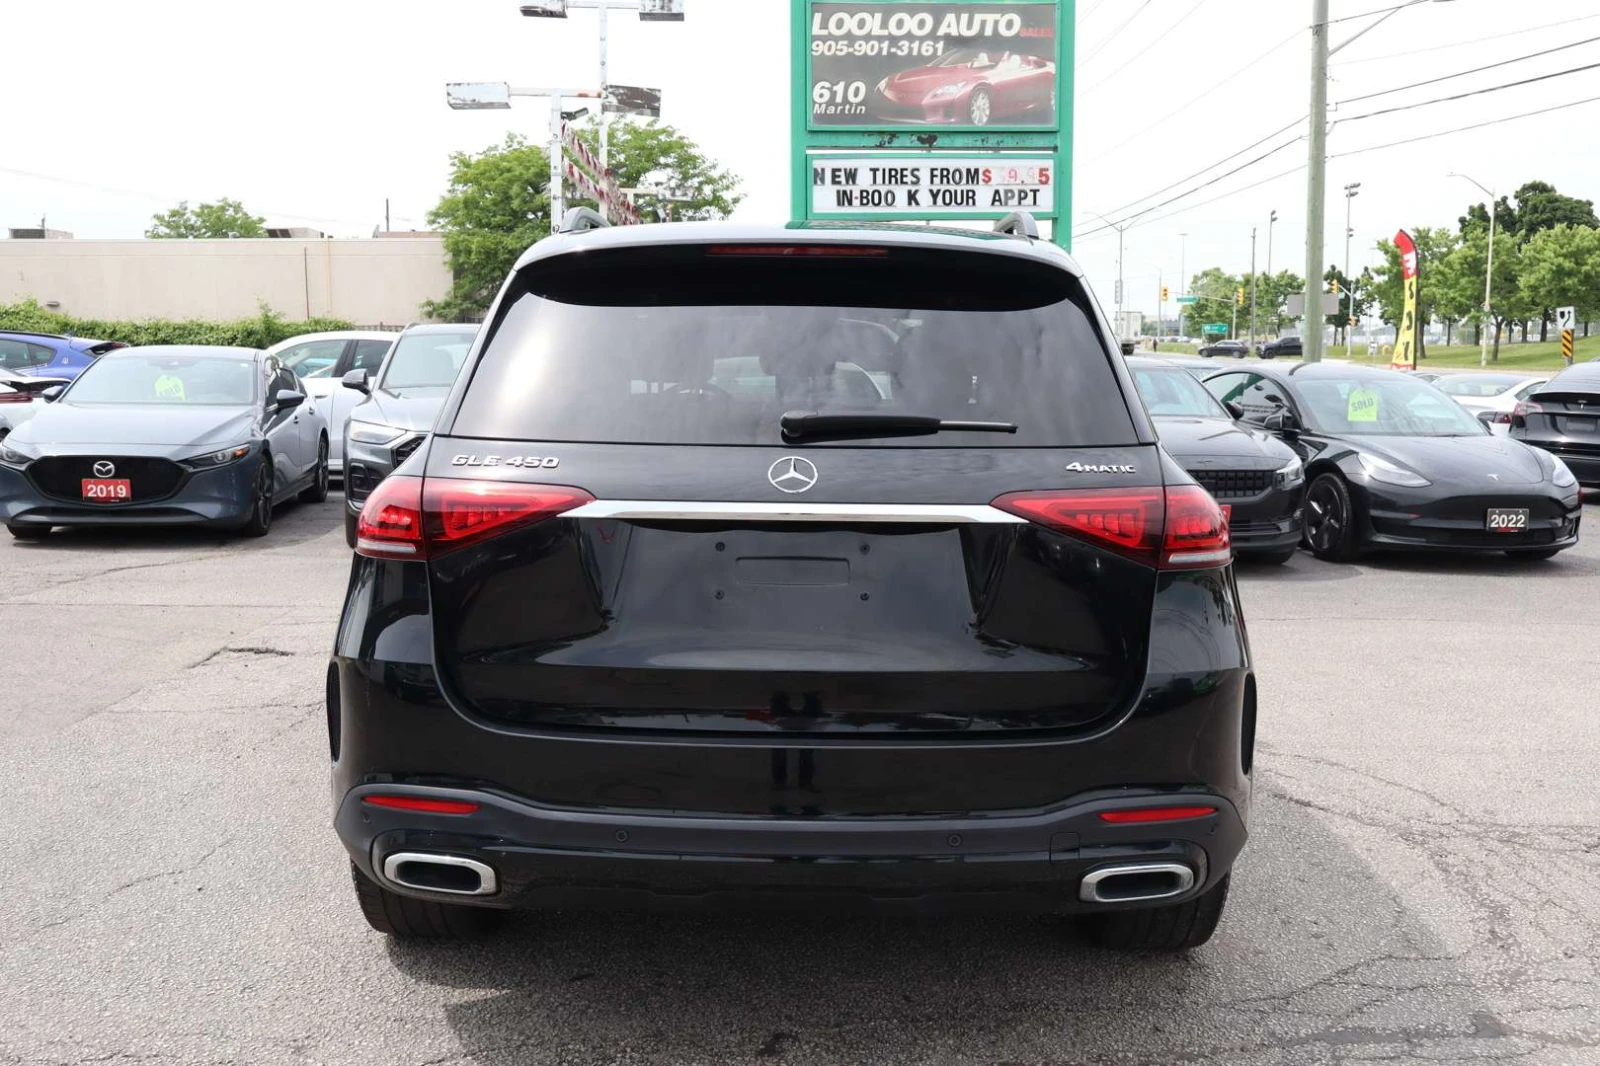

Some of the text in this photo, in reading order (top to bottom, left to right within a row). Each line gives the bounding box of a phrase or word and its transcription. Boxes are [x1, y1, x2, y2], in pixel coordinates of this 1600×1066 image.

[811, 12, 934, 36] LOOLOO
[936, 13, 1021, 37] AUTO
[811, 40, 944, 56] 905-901-3161
[812, 81, 866, 103] 610
[813, 103, 866, 114] Martin
[869, 168, 920, 185] TIRES
[928, 189, 976, 206] YOUR
[991, 189, 1040, 206] APPT
[1351, 397, 1375, 412] SOLD
[451, 454, 560, 469] GLE 450
[1065, 461, 1137, 474] 4MATIC
[87, 484, 127, 498] 2019
[1490, 514, 1526, 528] 2022
